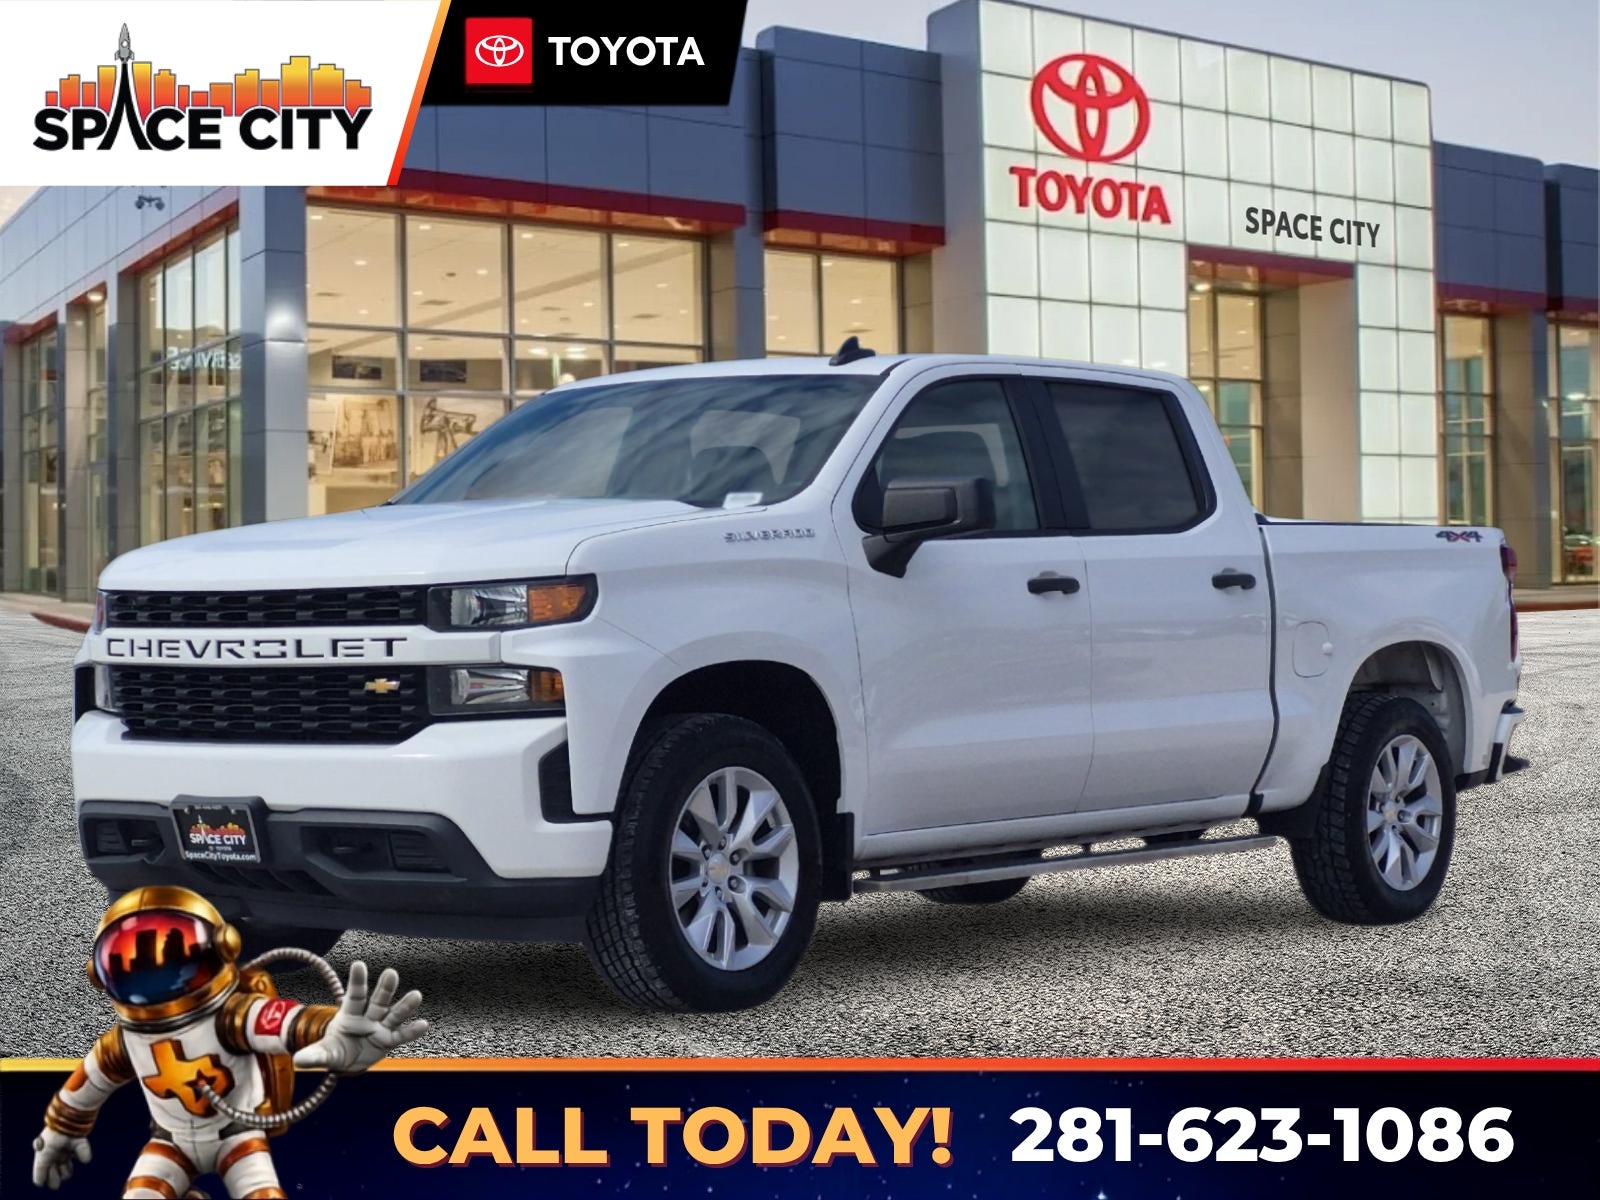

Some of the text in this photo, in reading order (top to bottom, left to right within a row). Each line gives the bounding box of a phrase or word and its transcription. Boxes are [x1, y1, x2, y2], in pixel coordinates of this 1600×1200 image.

[1009, 166, 1171, 224] TOYOTA
[1245, 206, 1381, 248] SPACE CITY
[106, 636, 408, 660] CHEVROLET
[190, 833, 246, 845] SPACE CITY
[186, 851, 256, 861] SpaceCityToyota.com
